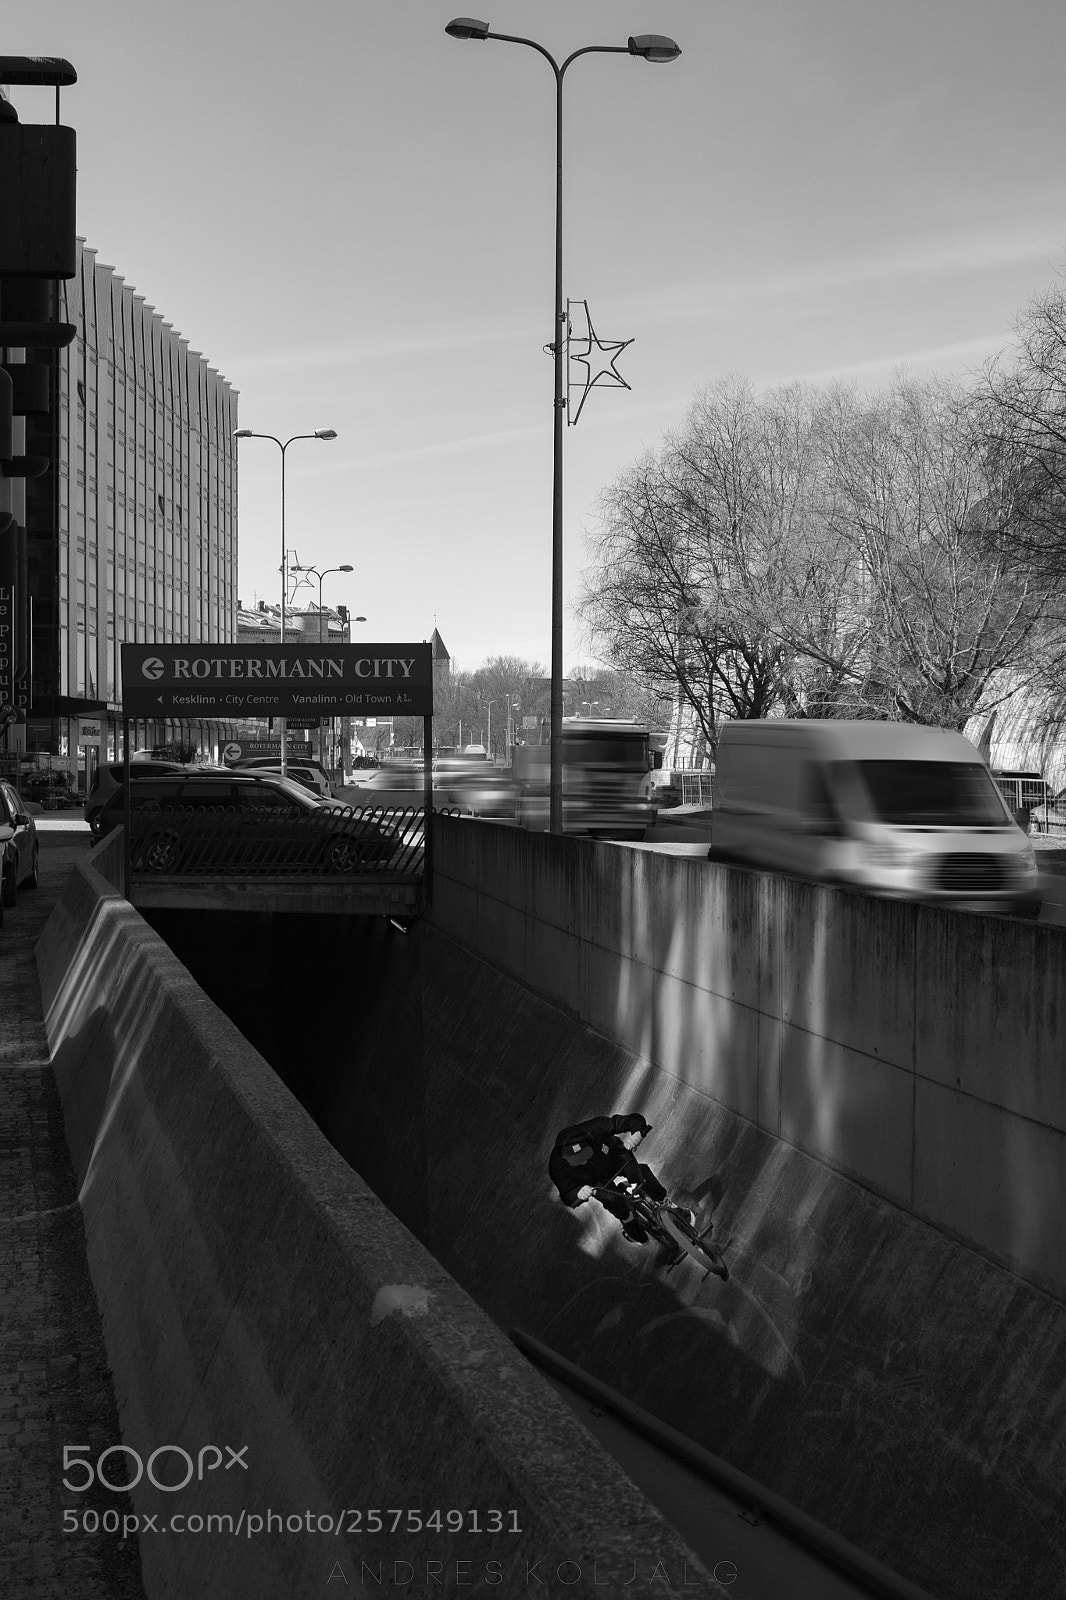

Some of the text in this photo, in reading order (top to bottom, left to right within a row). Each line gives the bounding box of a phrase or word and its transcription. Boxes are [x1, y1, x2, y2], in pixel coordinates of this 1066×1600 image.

[0, 588, 9, 615] Le
[173, 659, 416, 678] ROTERMANN CITY
[172, 694, 392, 707] Kesklinn City Centre Vanalinn Old Town
